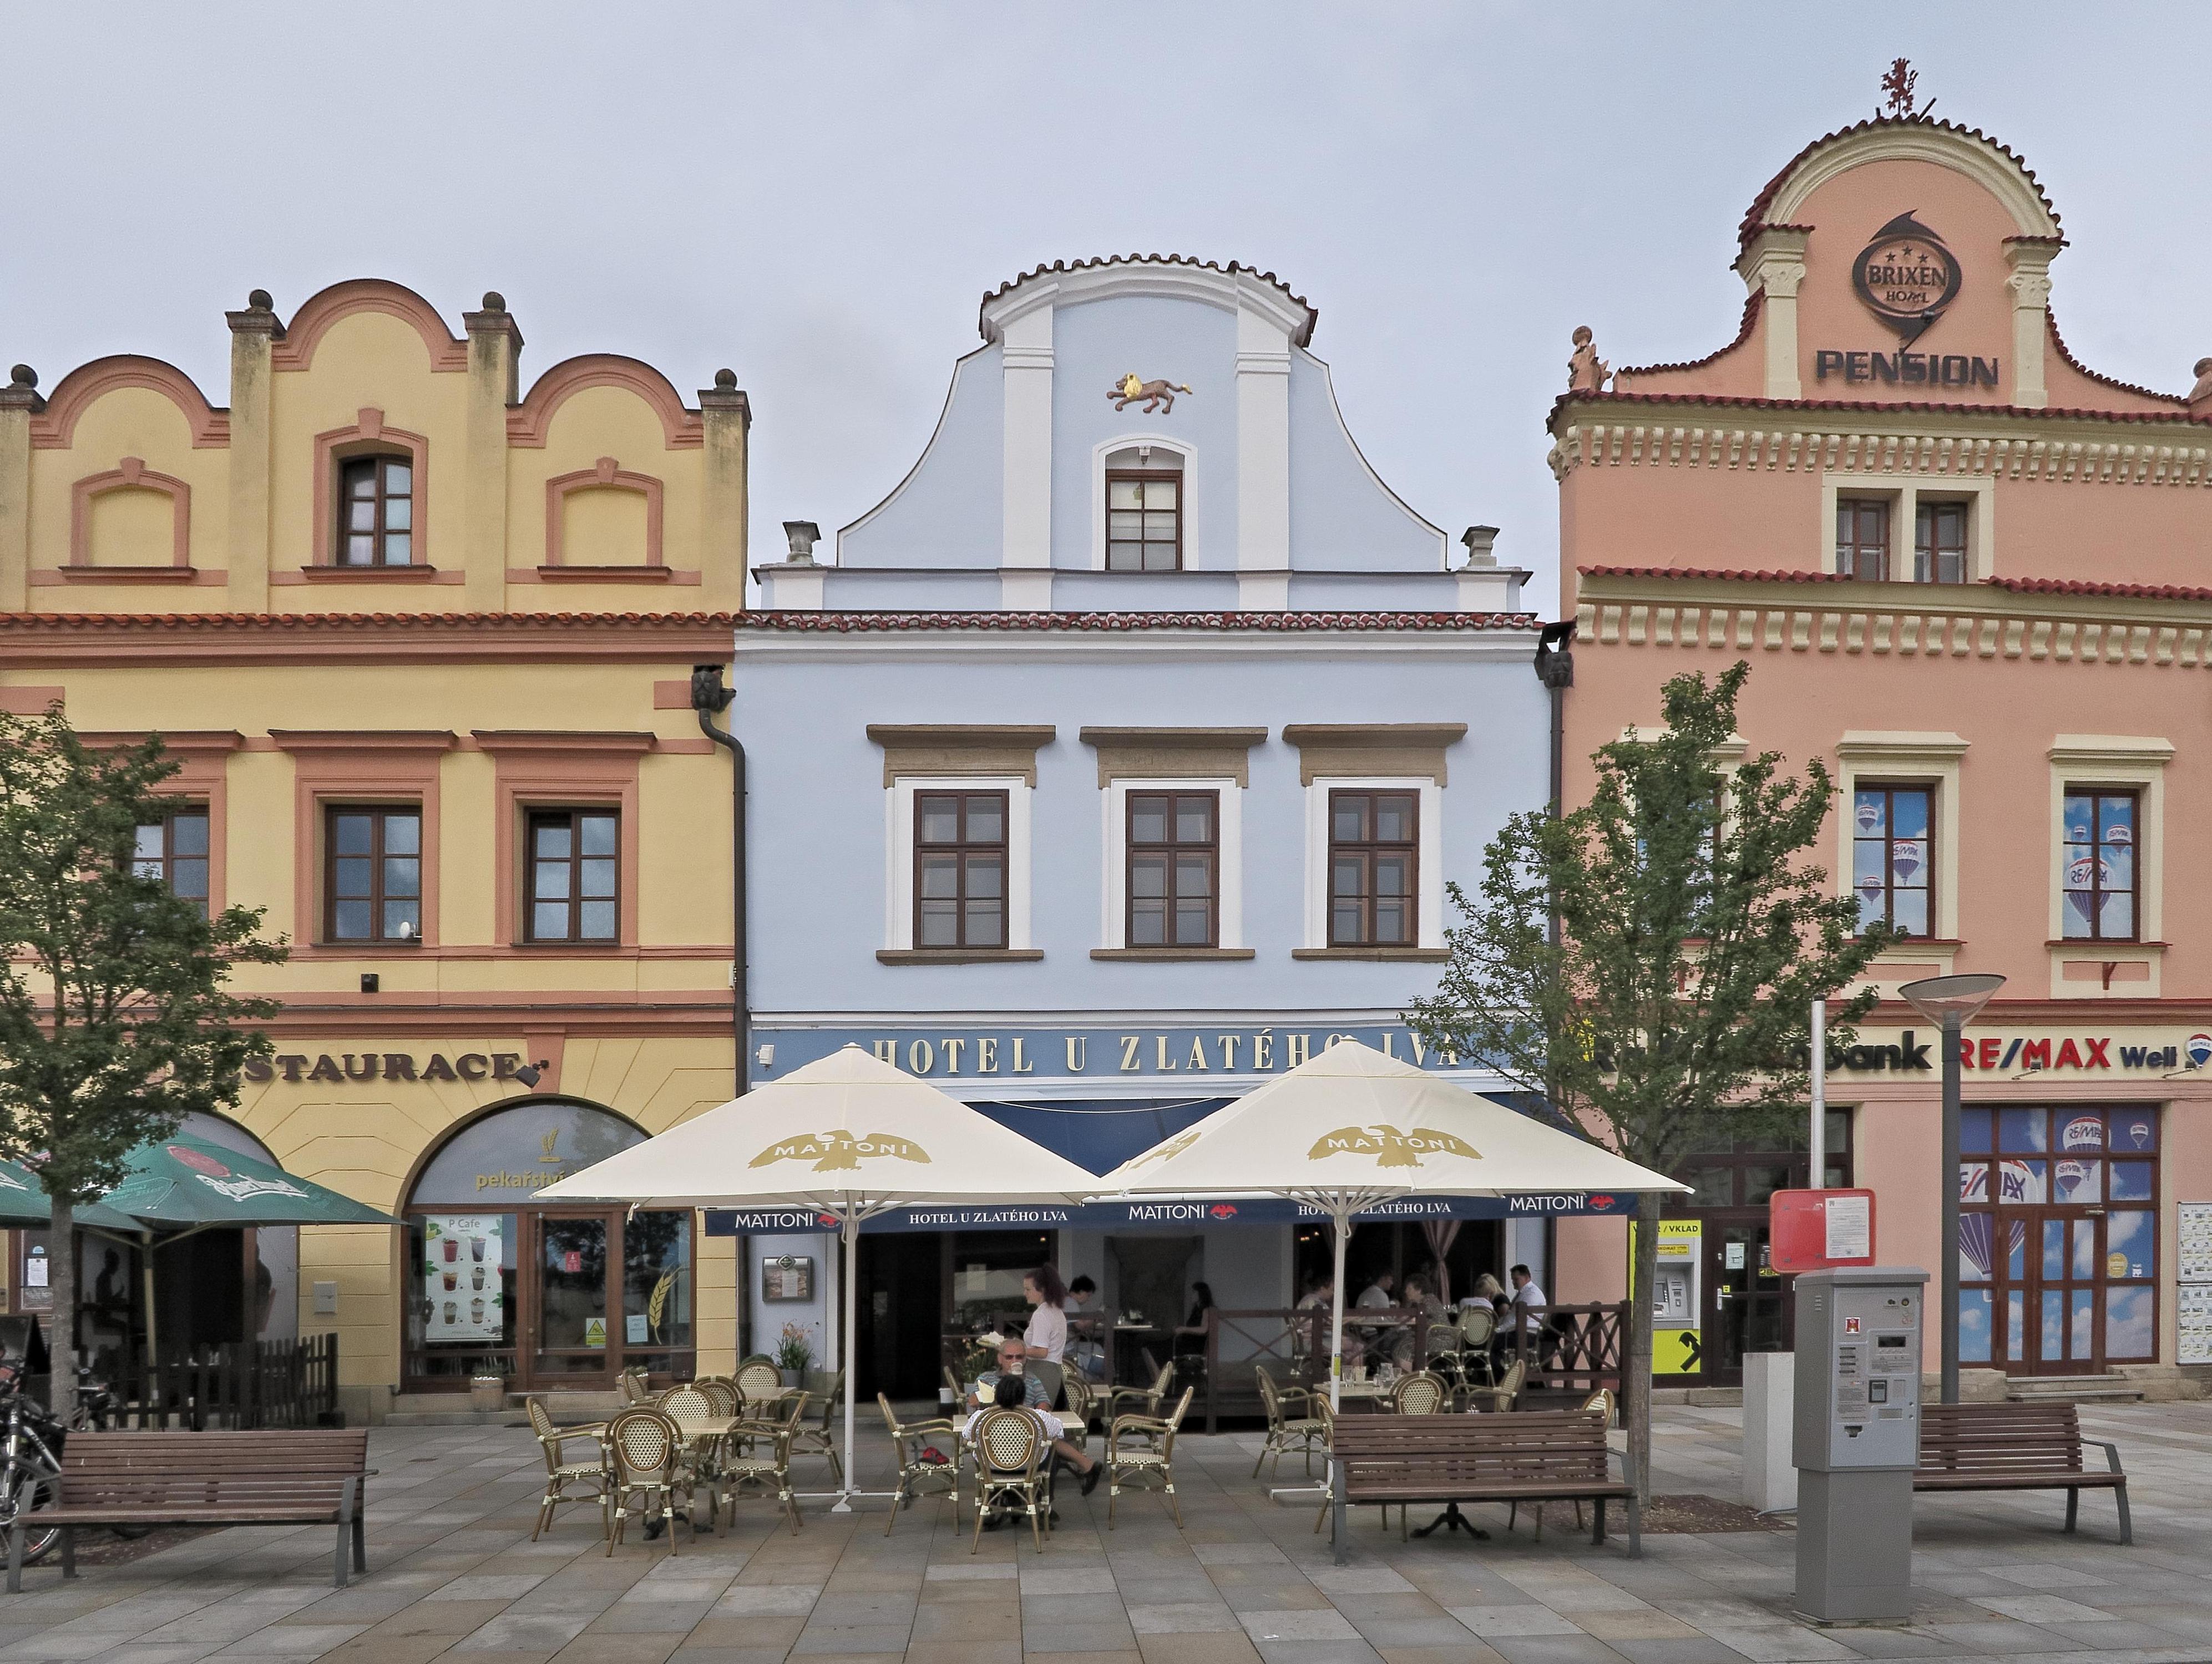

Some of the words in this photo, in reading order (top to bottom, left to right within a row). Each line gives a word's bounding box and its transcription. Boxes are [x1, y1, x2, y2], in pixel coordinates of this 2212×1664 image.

[1869, 265, 1947, 286] BRIXEN
[1816, 350, 1999, 385] PENSION
[873, 1037, 1033, 1074] HOTEL
[1065, 1037, 1087, 1072] U
[1961, 1038, 2111, 1068] RE/MAX
[2119, 1046, 2177, 1067] Well
[225, 1053, 519, 1081] STAURACE
[774, 1140, 908, 1156] MATTONI
[1327, 1136, 1457, 1150] MATTONI
[1426, 1203, 1451, 1213] LVA
[1510, 1195, 1584, 1211] MATTONI
[909, 1213, 957, 1224] HOTEL
[960, 1213, 970, 1223] U
[973, 1209, 1039, 1223] ZLATÉHO
[1042, 1210, 1068, 1221] LVA
[1128, 1204, 1204, 1220] MATTONI
[449, 1219, 455, 1228] P
[735, 1213, 813, 1229] MATTONI
